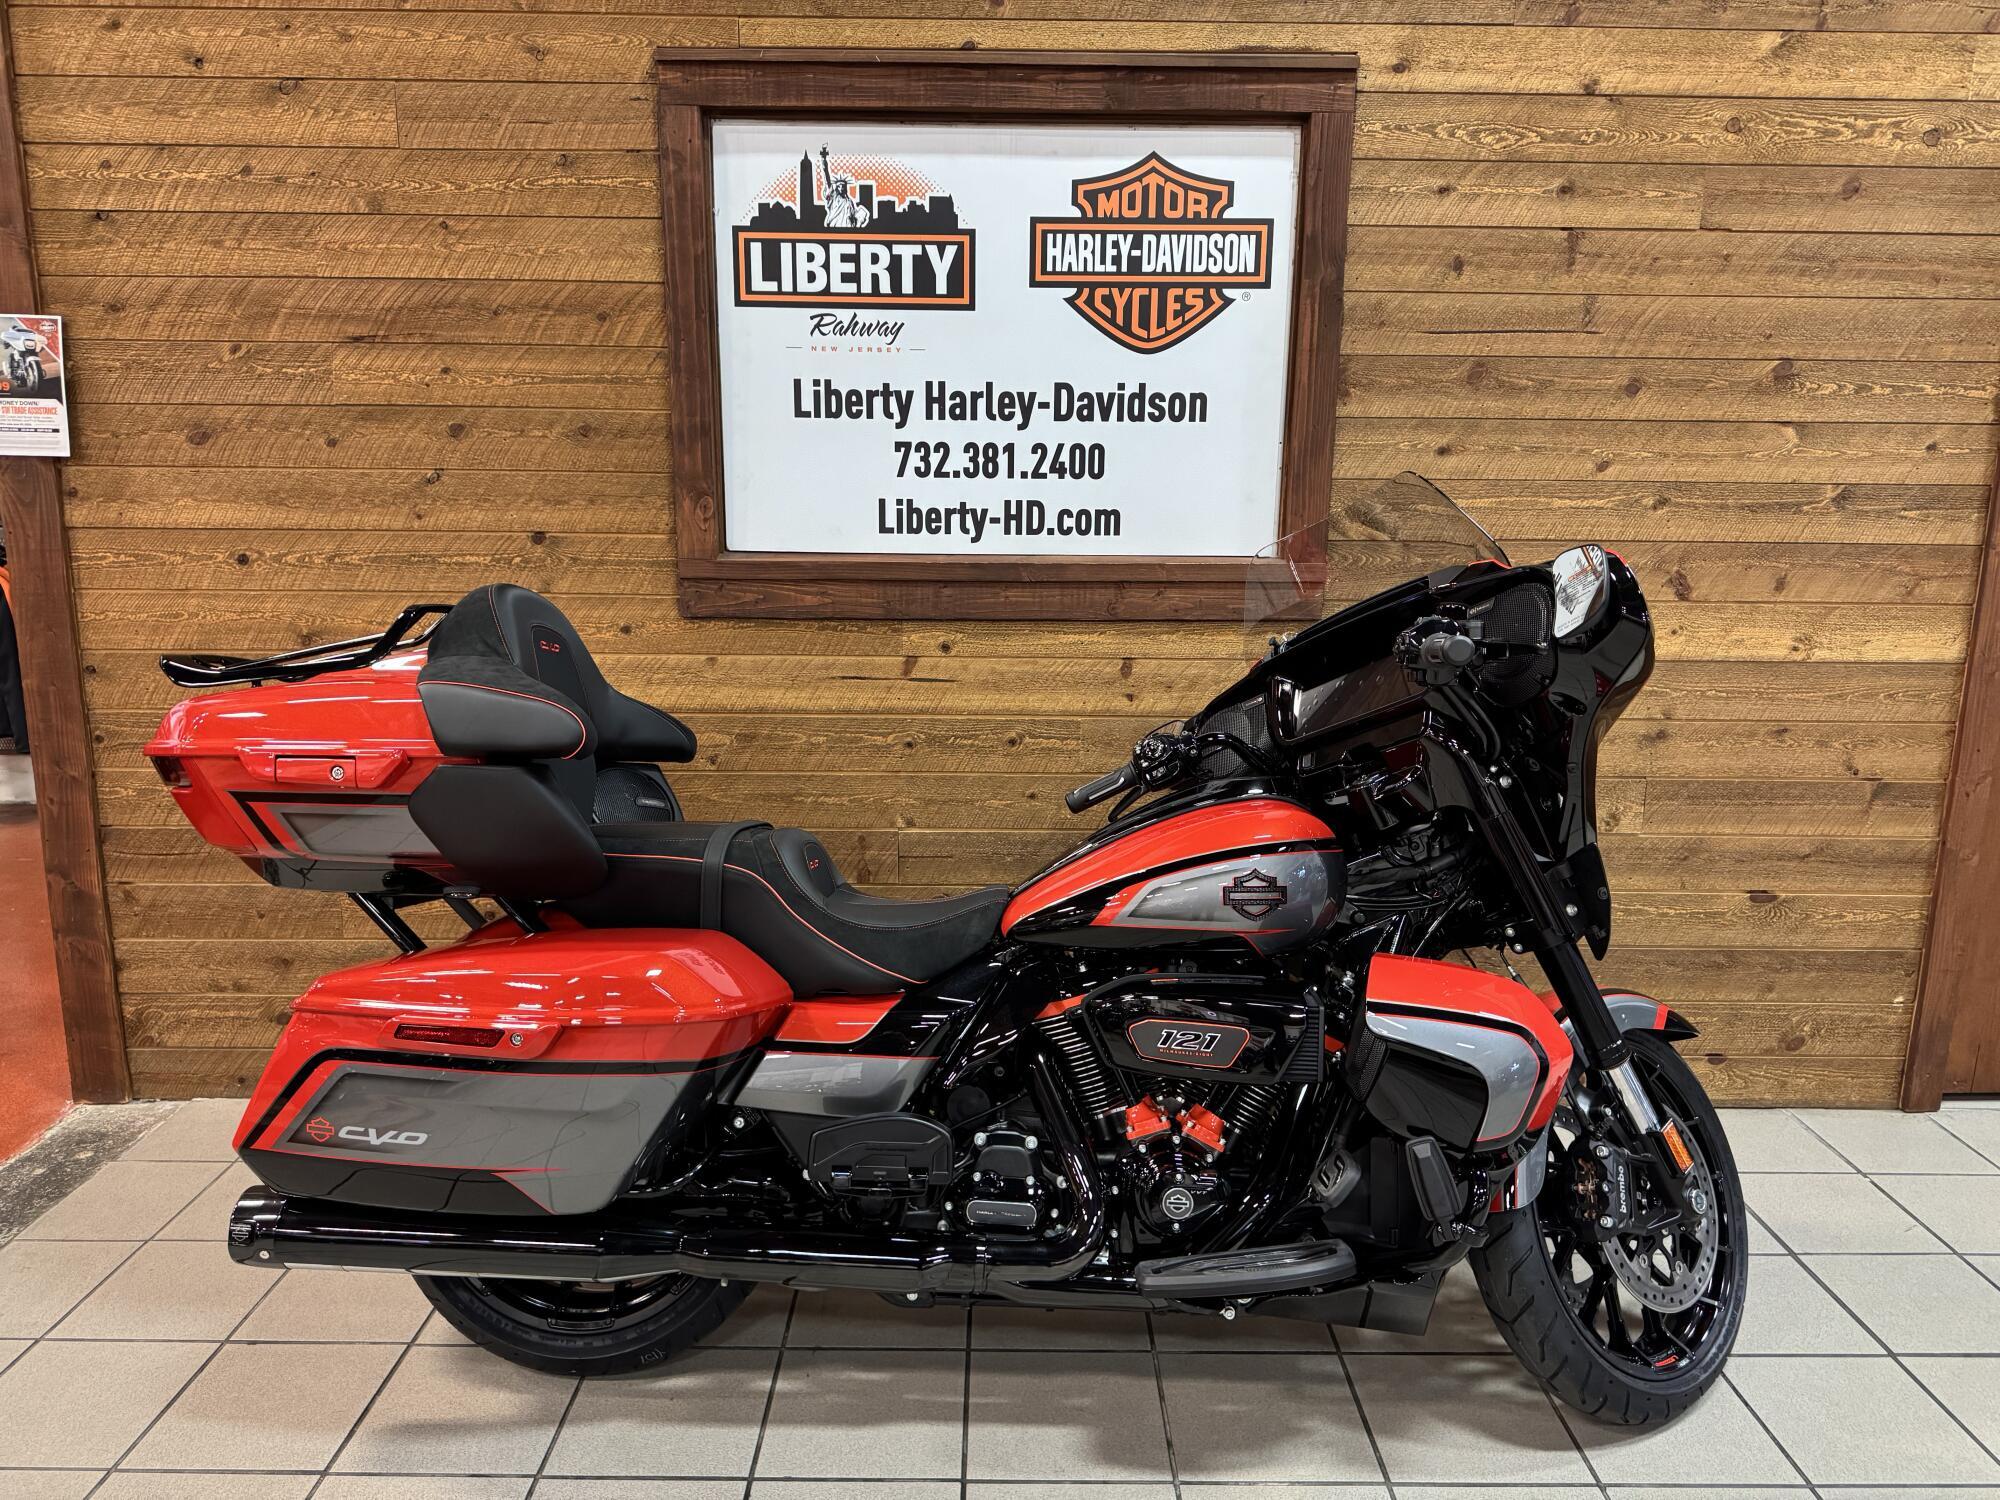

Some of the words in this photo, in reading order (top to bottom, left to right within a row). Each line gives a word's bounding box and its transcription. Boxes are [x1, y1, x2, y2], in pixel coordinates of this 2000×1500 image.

[1097, 172, 1209, 219] MOTOR
[750, 241, 958, 295] LIBERTY
[1046, 233, 1256, 274] HARLEY-DAVIDSON
[810, 312, 905, 345] Rahway
[1094, 287, 1204, 339] CYCLES
[793, 378, 915, 430] Liberty
[925, 380, 1208, 431] Harley-Davidson
[894, 441, 1106, 480] 732.381.2400
[878, 498, 1121, 544] Liberty-HD.com
[1157, 1029, 1221, 1052] 121
[338, 1125, 429, 1145] CVO
[1617, 1165, 1628, 1214] brembo
